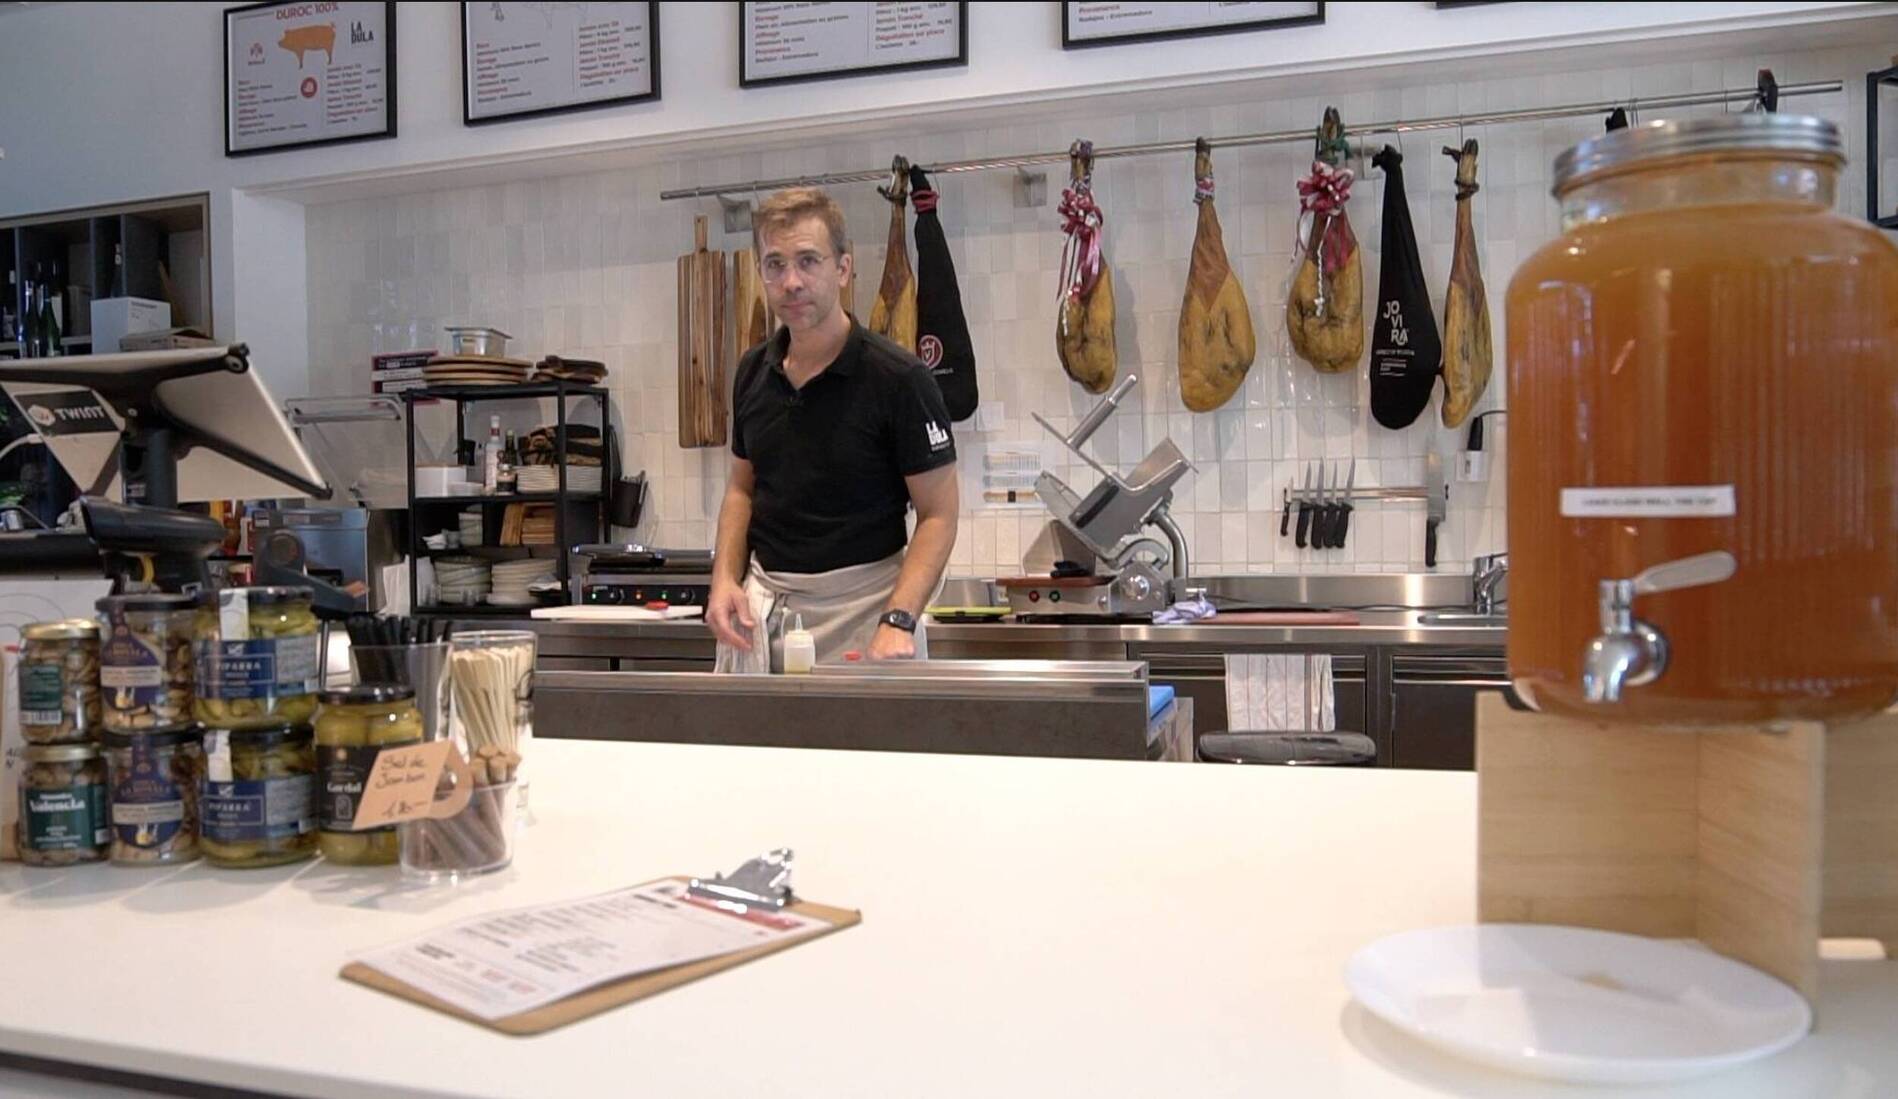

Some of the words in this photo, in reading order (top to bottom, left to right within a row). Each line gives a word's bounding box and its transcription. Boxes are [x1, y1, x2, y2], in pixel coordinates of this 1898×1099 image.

[276, 4, 313, 20] DUROC
[54, 405, 104, 420] TWINT
[30, 797, 86, 813] Valencia
